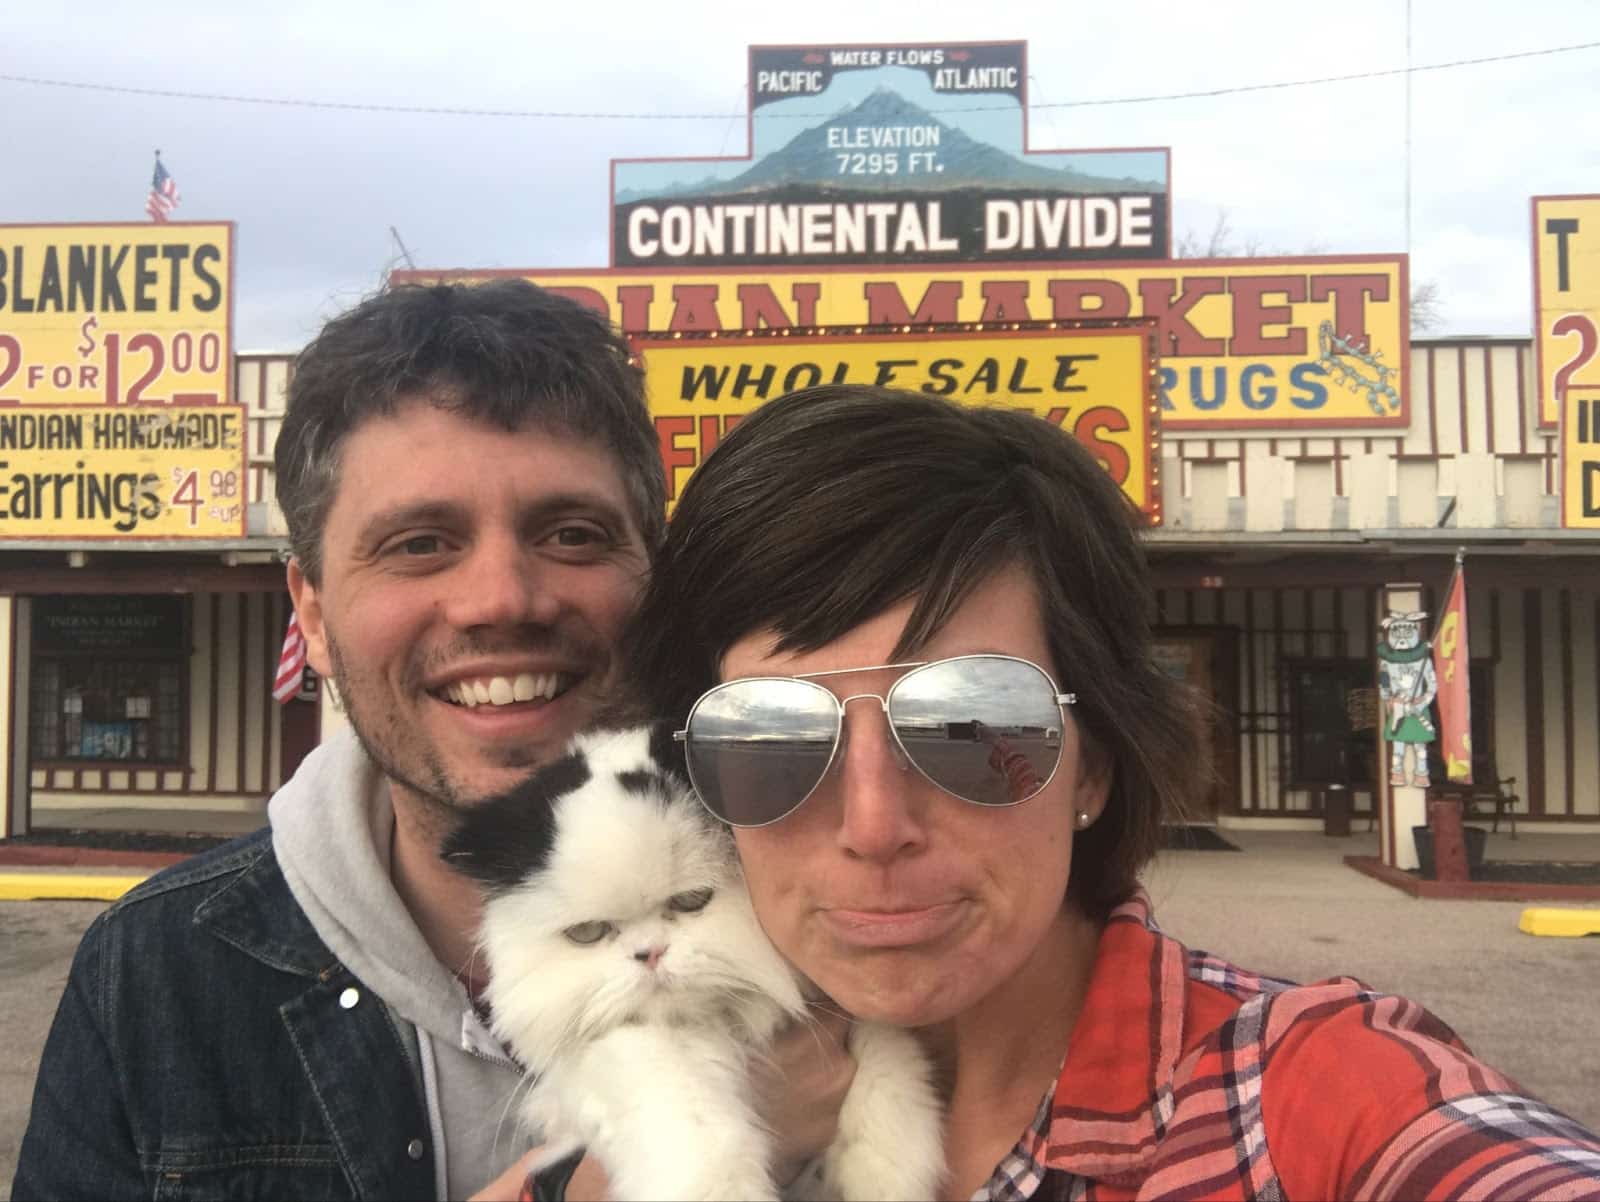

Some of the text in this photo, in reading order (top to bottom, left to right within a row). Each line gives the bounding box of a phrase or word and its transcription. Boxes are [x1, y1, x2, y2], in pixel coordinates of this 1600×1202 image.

[831, 49, 945, 66] WATER FLOWS
[757, 71, 823, 93] PACIFIC
[934, 68, 1018, 90] ATLANTIC
[827, 126, 940, 149] ELEVATION
[836, 152, 946, 175] 7295 FT.
[627, 197, 1152, 257] CONTINENTAL DIVIDE
[863, 273, 1391, 357] MARKET
[27, 366, 99, 389] FOR
[94, 413, 236, 450] HANDMADE
